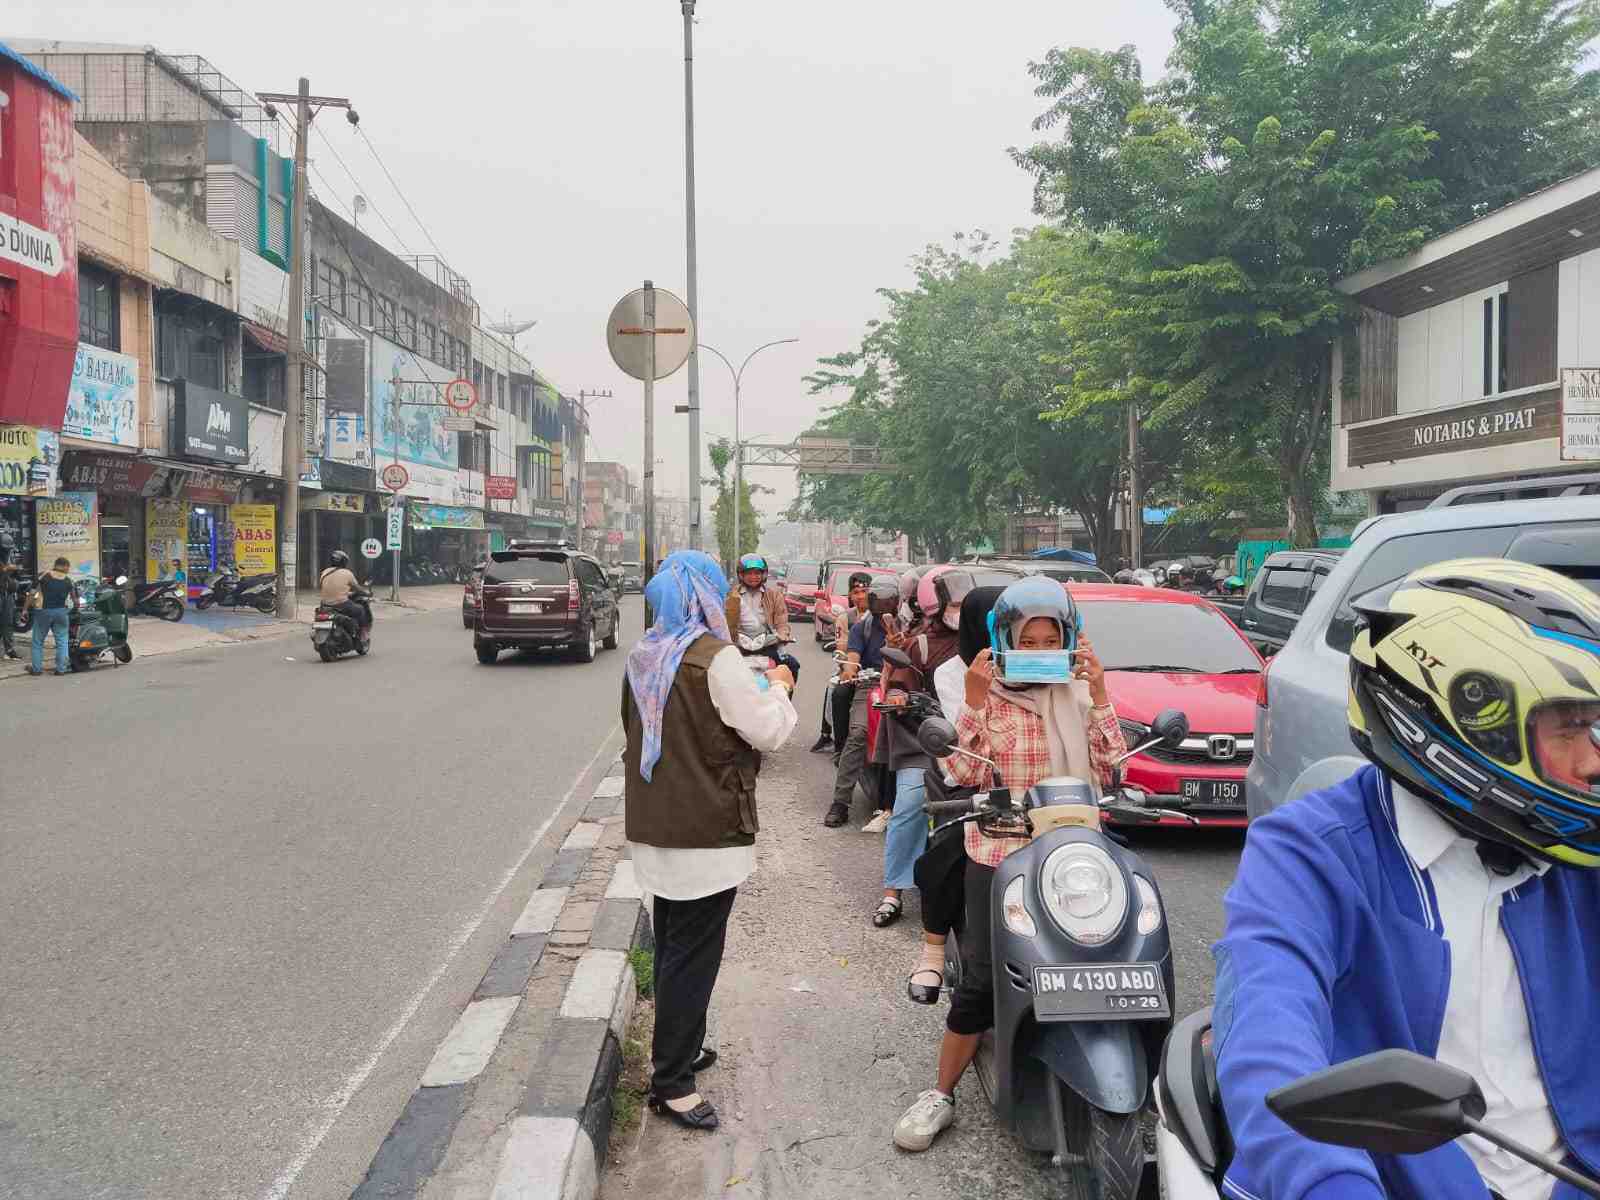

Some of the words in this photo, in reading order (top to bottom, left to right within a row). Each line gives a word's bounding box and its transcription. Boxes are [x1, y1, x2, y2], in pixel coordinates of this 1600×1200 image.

[10, 228, 54, 267] DUNIA
[1413, 418, 1475, 446] NOTARIS
[1478, 416, 1490, 435] &
[1494, 407, 1536, 433] PPAT
[234, 527, 273, 541] ABAS
[1405, 640, 1447, 669] KYT
[1185, 783, 1200, 797] BM
[1212, 783, 1238, 797] 1150
[1040, 972, 1066, 992] BM
[1072, 971, 1117, 991] 4130
